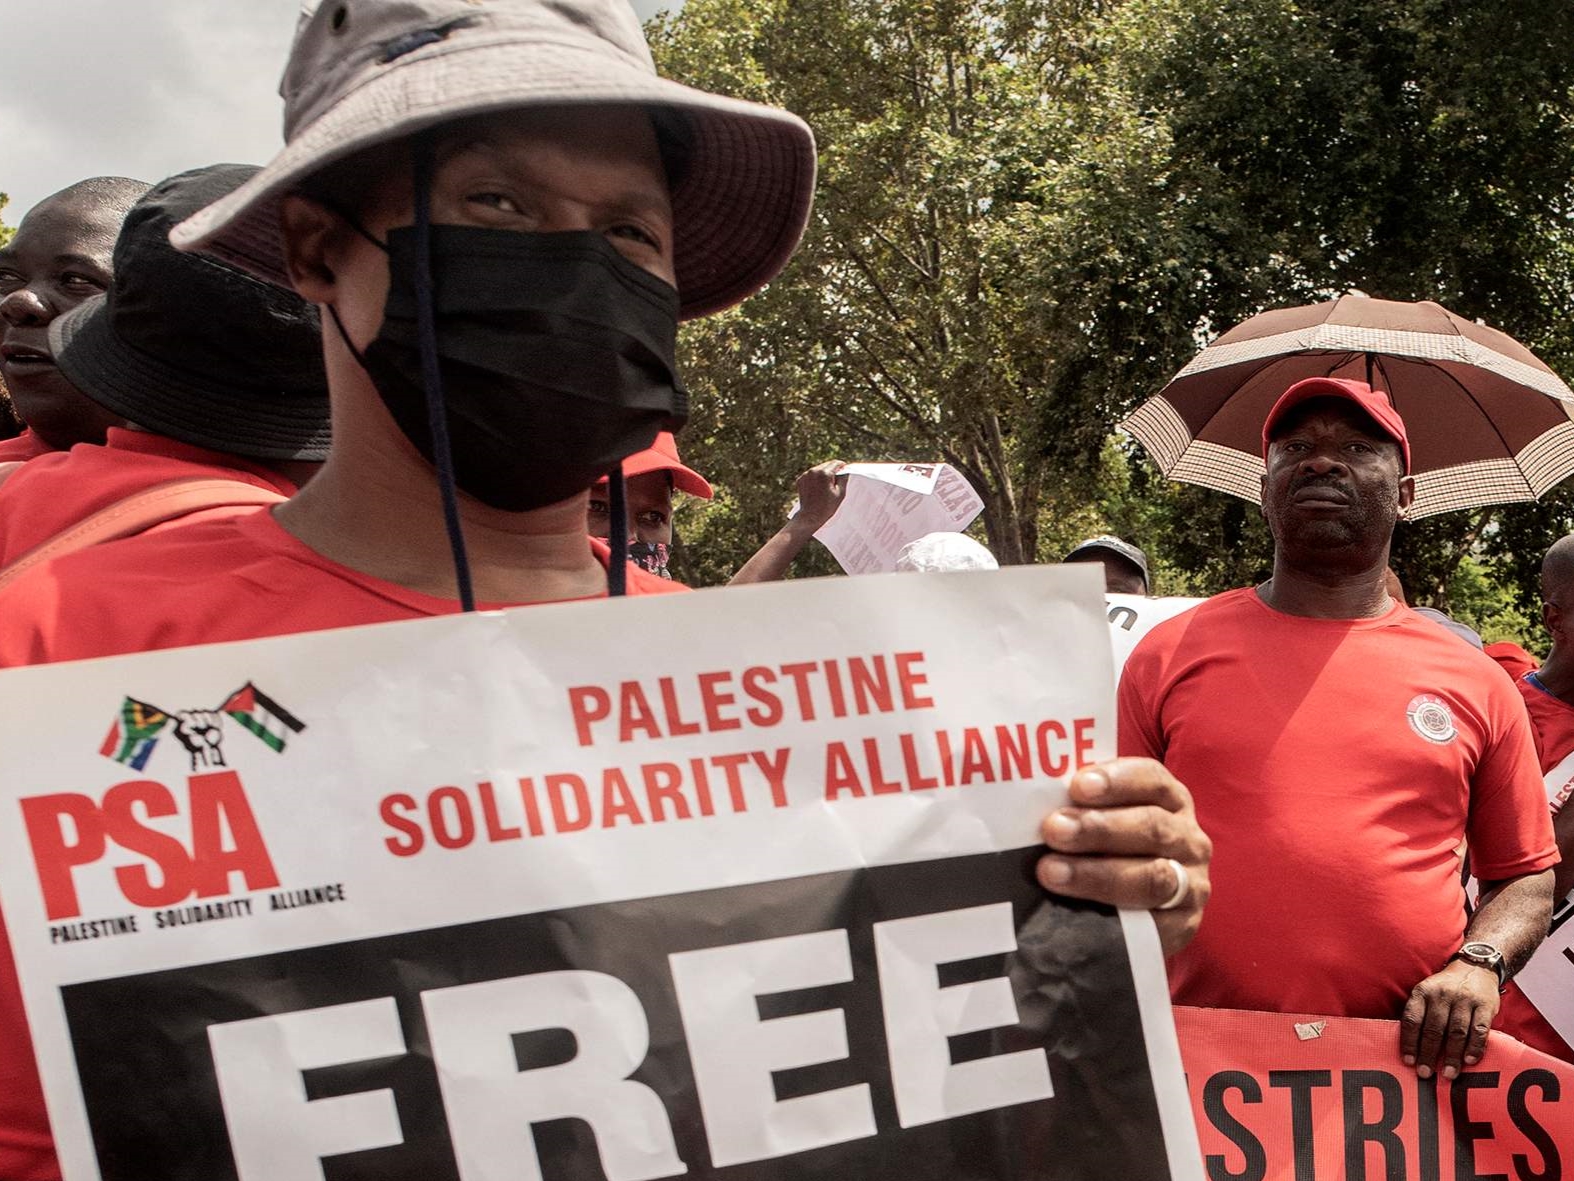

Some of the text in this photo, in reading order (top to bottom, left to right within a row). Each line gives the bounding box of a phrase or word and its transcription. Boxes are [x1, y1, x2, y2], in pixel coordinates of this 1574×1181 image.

[567, 651, 935, 746] PALESTINE
[19, 769, 280, 921] PSA
[378, 716, 1097, 857] SOLIDARITY ALLIANCE
[50, 882, 346, 945] PALESTINE SOLIDARITY ALLIANCE
